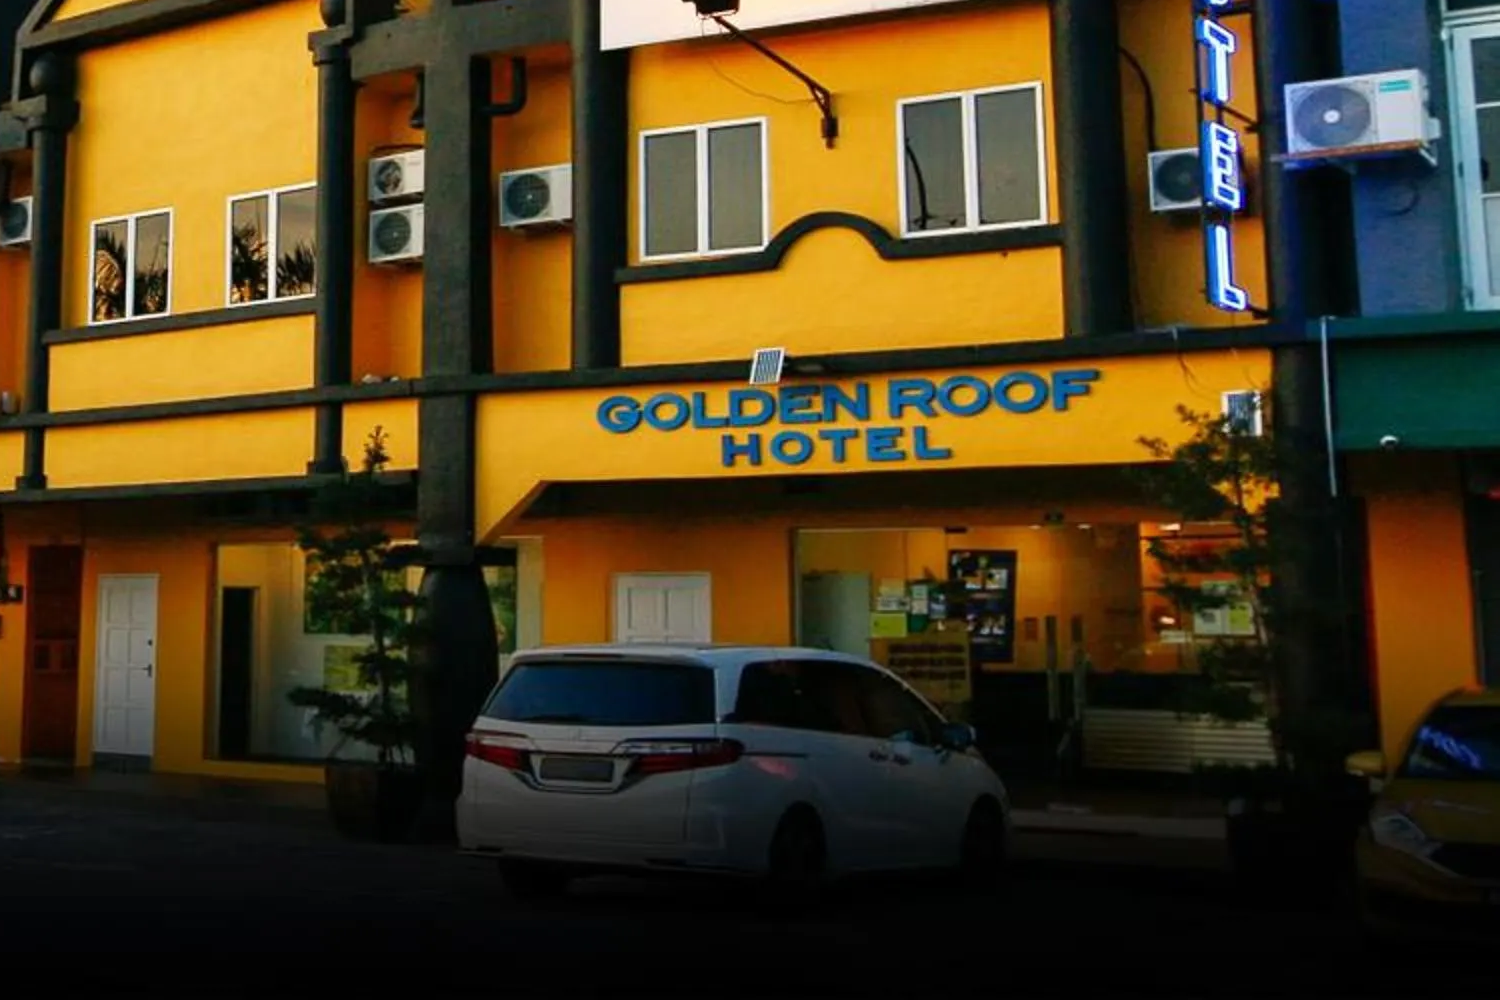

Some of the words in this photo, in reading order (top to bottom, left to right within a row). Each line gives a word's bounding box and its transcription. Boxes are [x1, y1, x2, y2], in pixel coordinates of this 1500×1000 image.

[595, 378, 874, 435] GOLDEN
[886, 368, 1103, 420] ROOF
[720, 424, 955, 468] HOTEL
